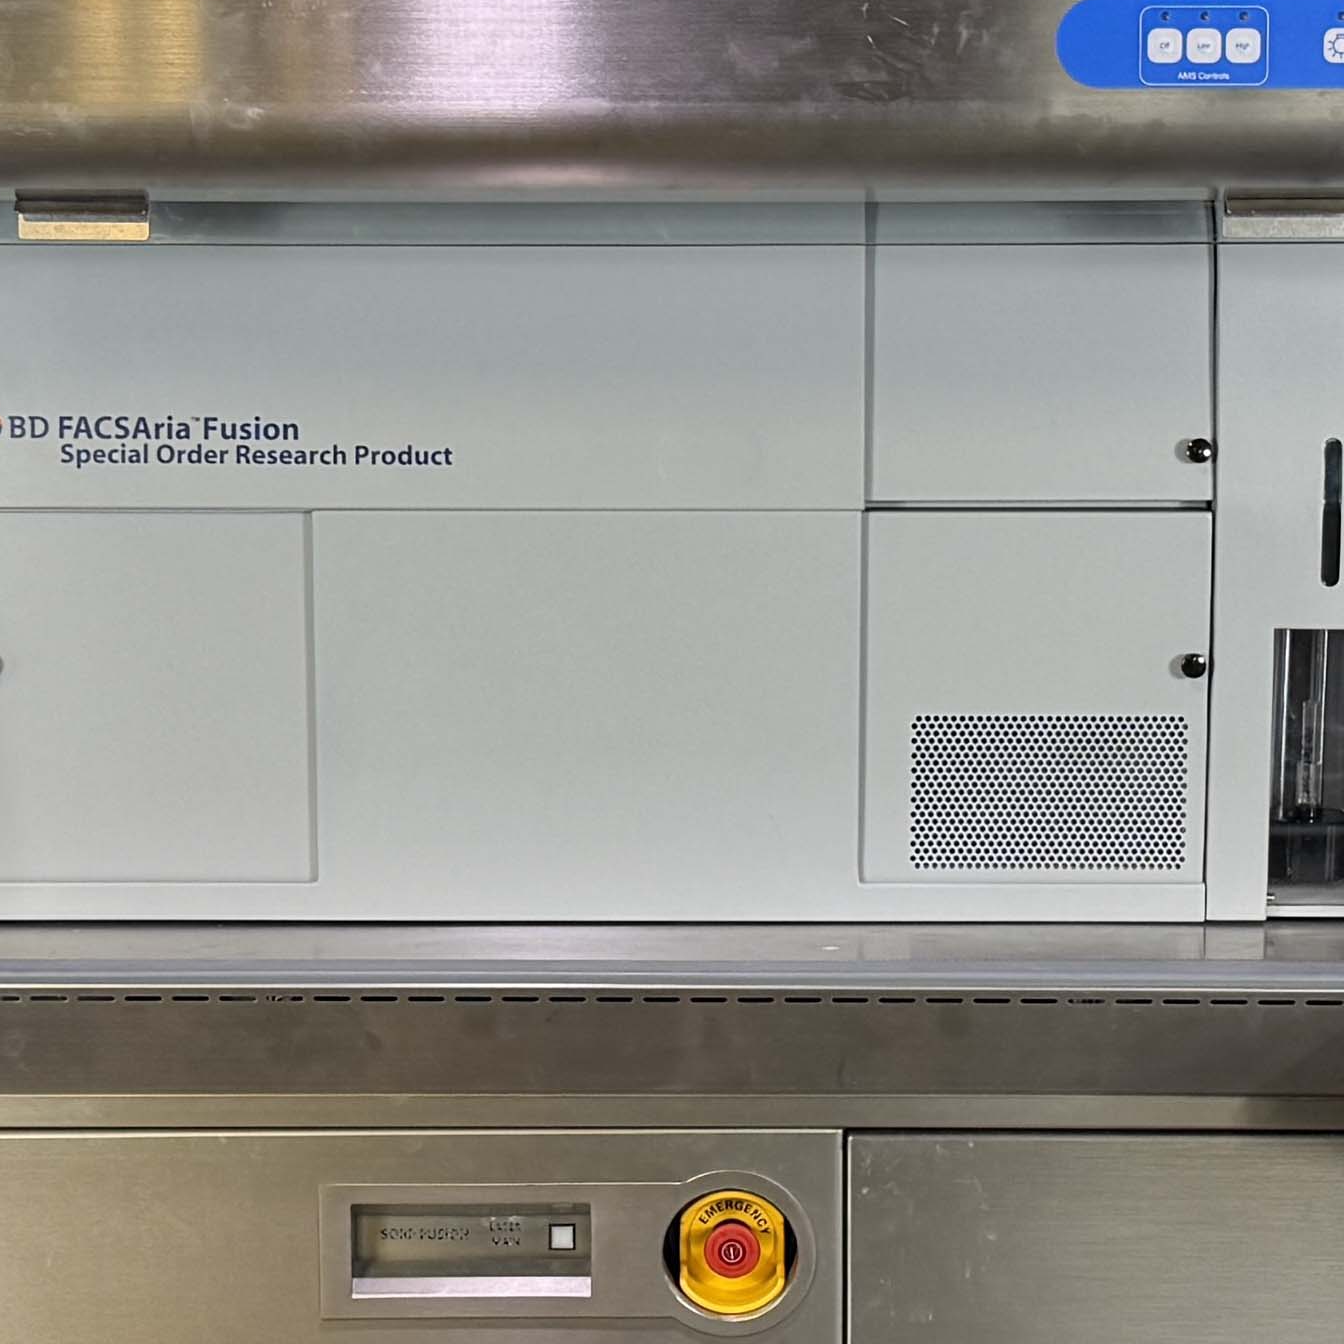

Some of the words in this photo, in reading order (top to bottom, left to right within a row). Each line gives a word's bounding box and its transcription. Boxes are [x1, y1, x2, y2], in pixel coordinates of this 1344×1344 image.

[9, 417, 49, 439] BD
[204, 416, 299, 440] Fusion
[61, 444, 150, 469] Special
[156, 444, 228, 465] Order
[236, 444, 347, 465] Research
[354, 445, 453, 466] Product
[699, 1199, 771, 1235] EMERGENCY
